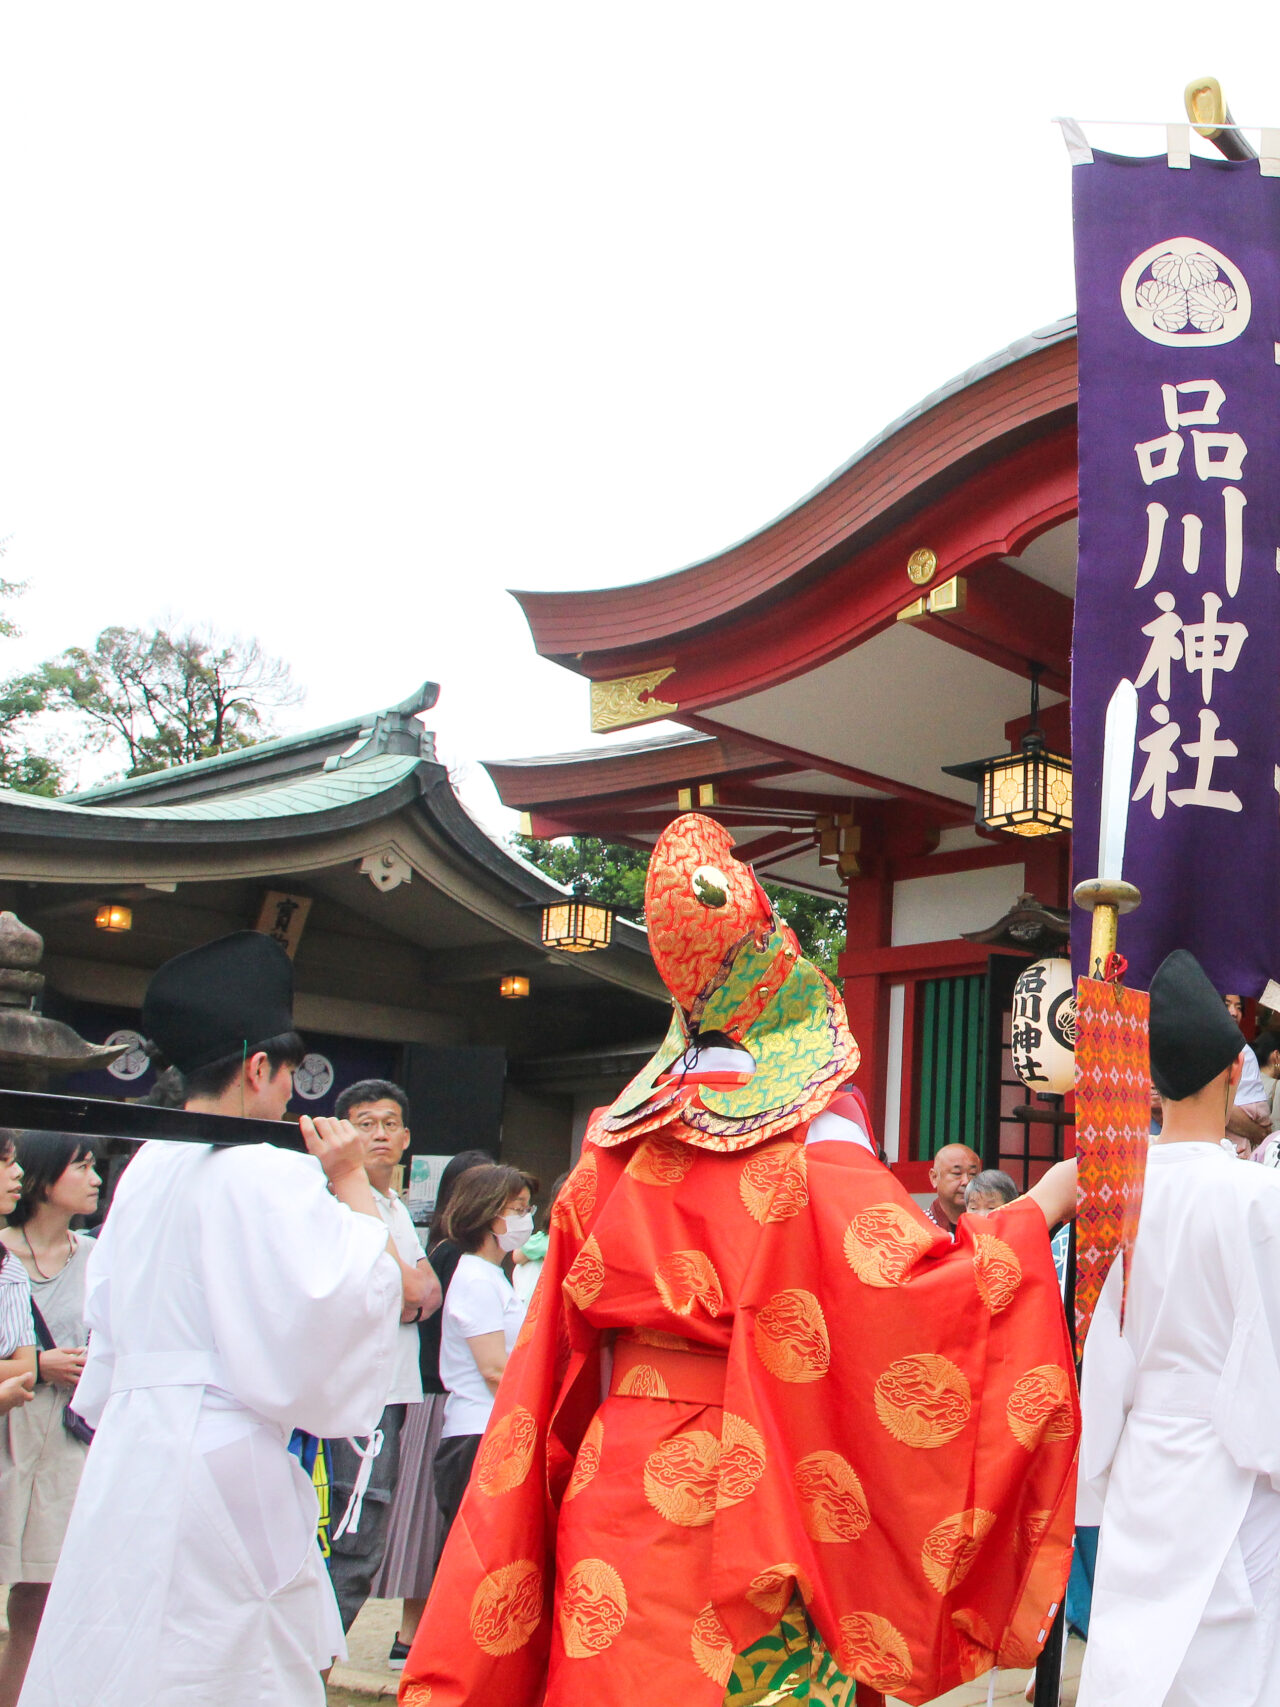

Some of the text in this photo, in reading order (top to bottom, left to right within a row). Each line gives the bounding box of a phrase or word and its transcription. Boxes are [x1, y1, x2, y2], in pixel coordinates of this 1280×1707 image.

[1132, 379, 1248, 820] 品川神社
[1012, 966, 1049, 1083] 品川神社
